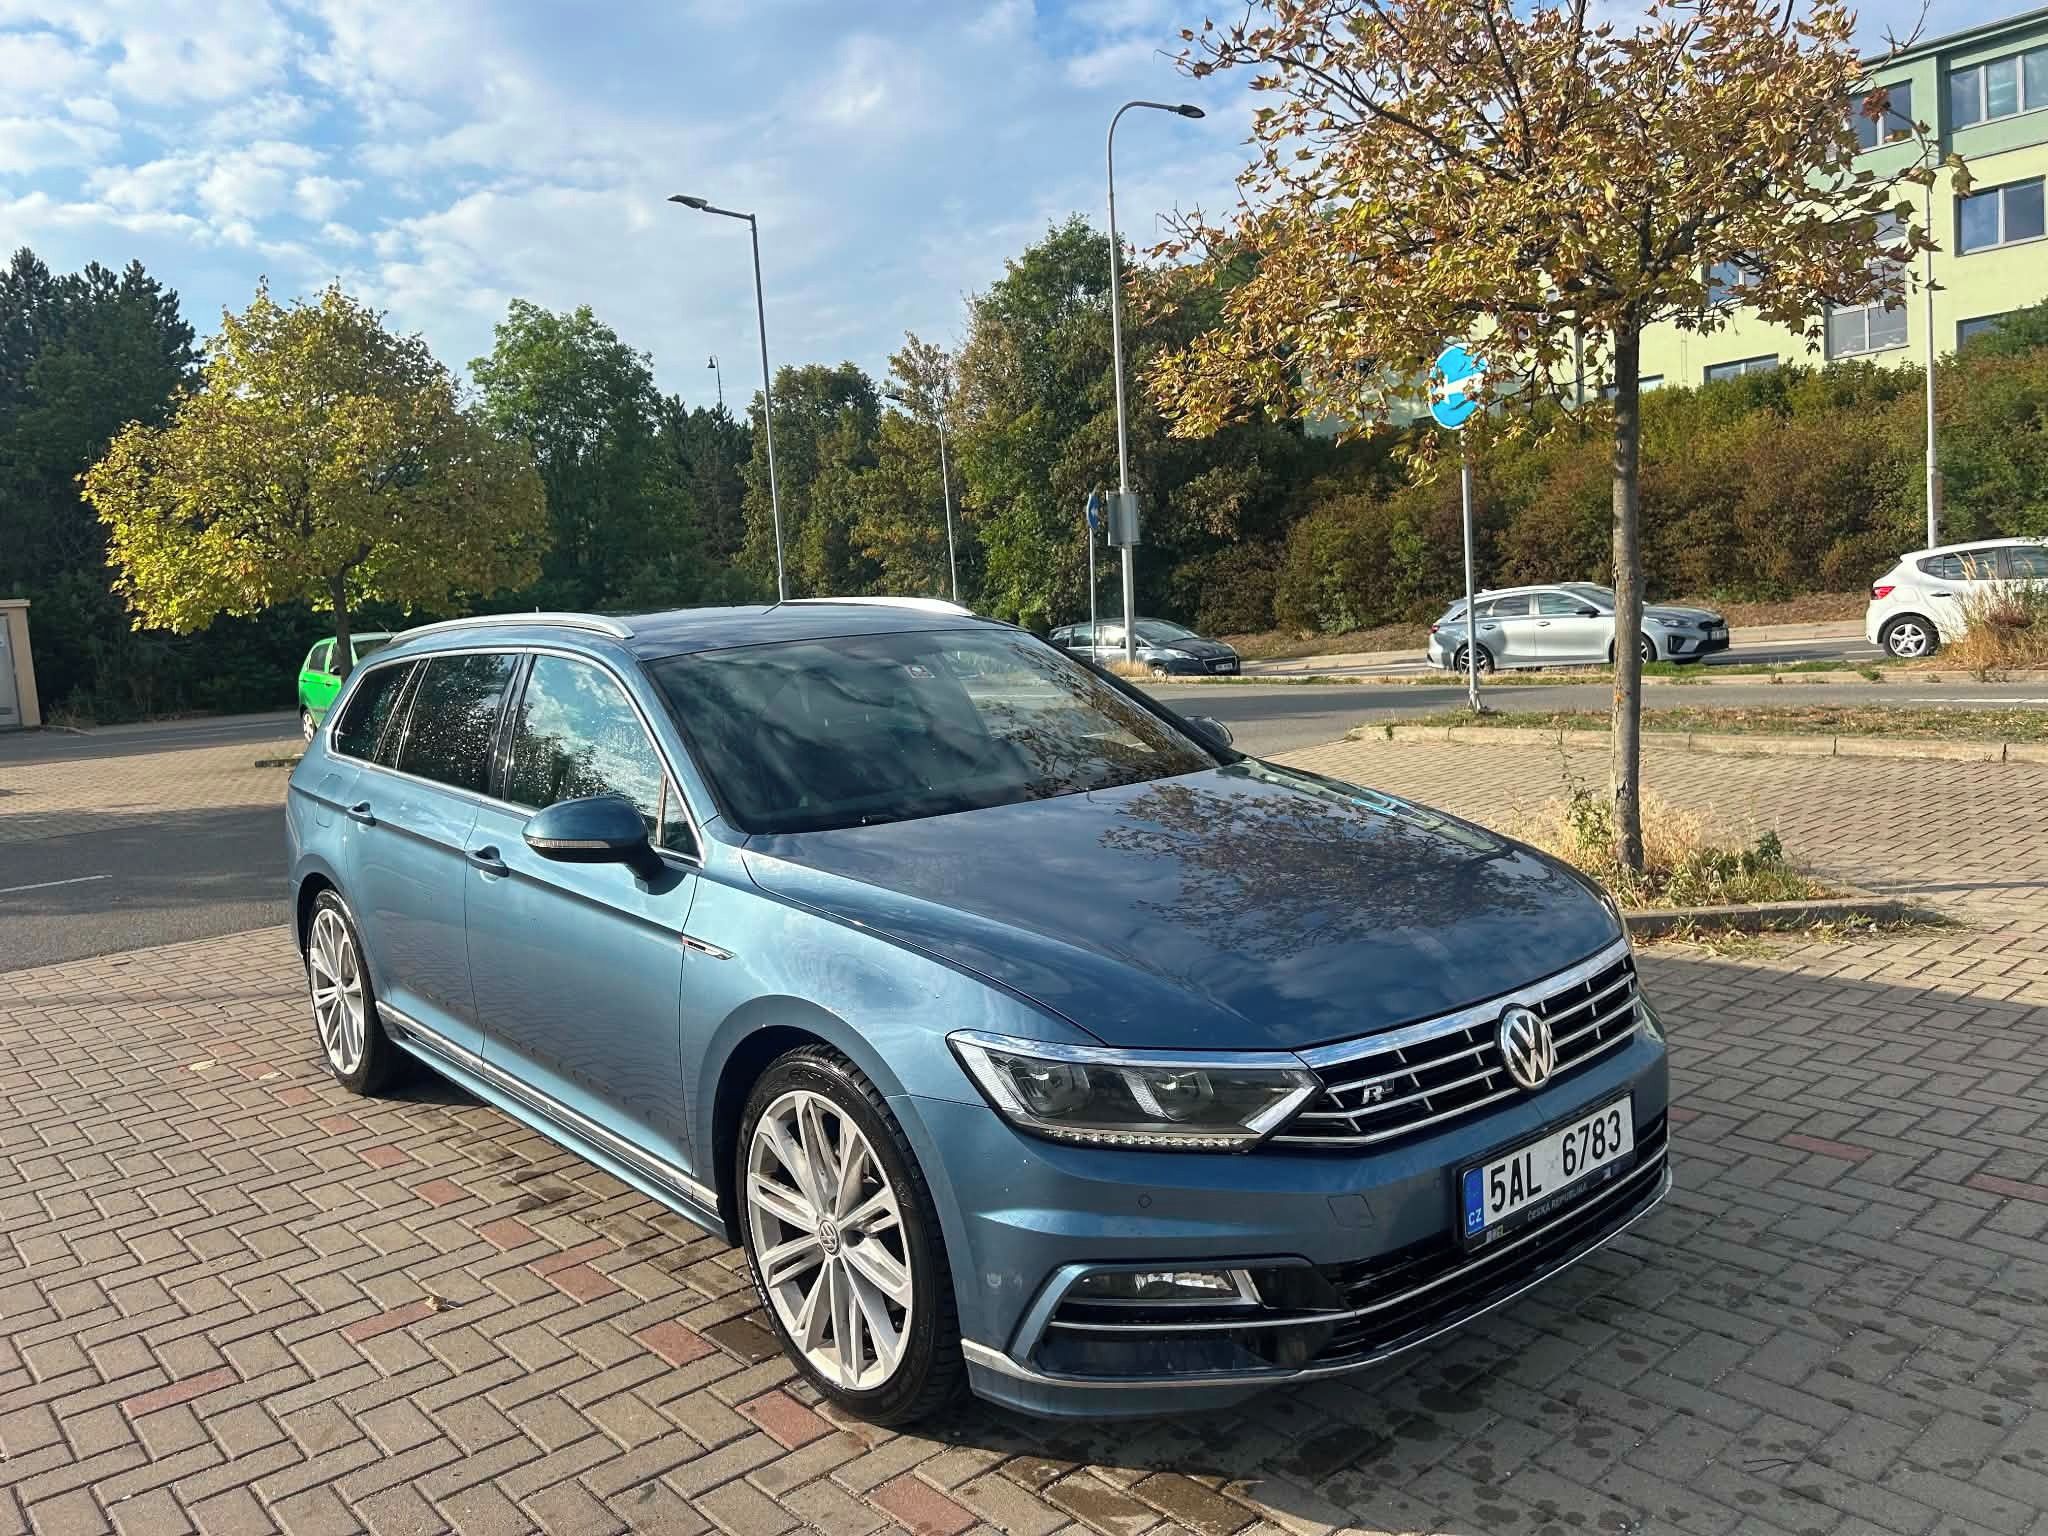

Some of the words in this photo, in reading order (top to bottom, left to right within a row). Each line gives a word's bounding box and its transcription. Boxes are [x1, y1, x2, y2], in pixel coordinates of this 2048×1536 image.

[1501, 1008, 1554, 1088] VW
[1490, 1152, 1542, 1213] 5AL
[1562, 1110, 1621, 1177] 6783
[1468, 1207, 1482, 1227] CZ
